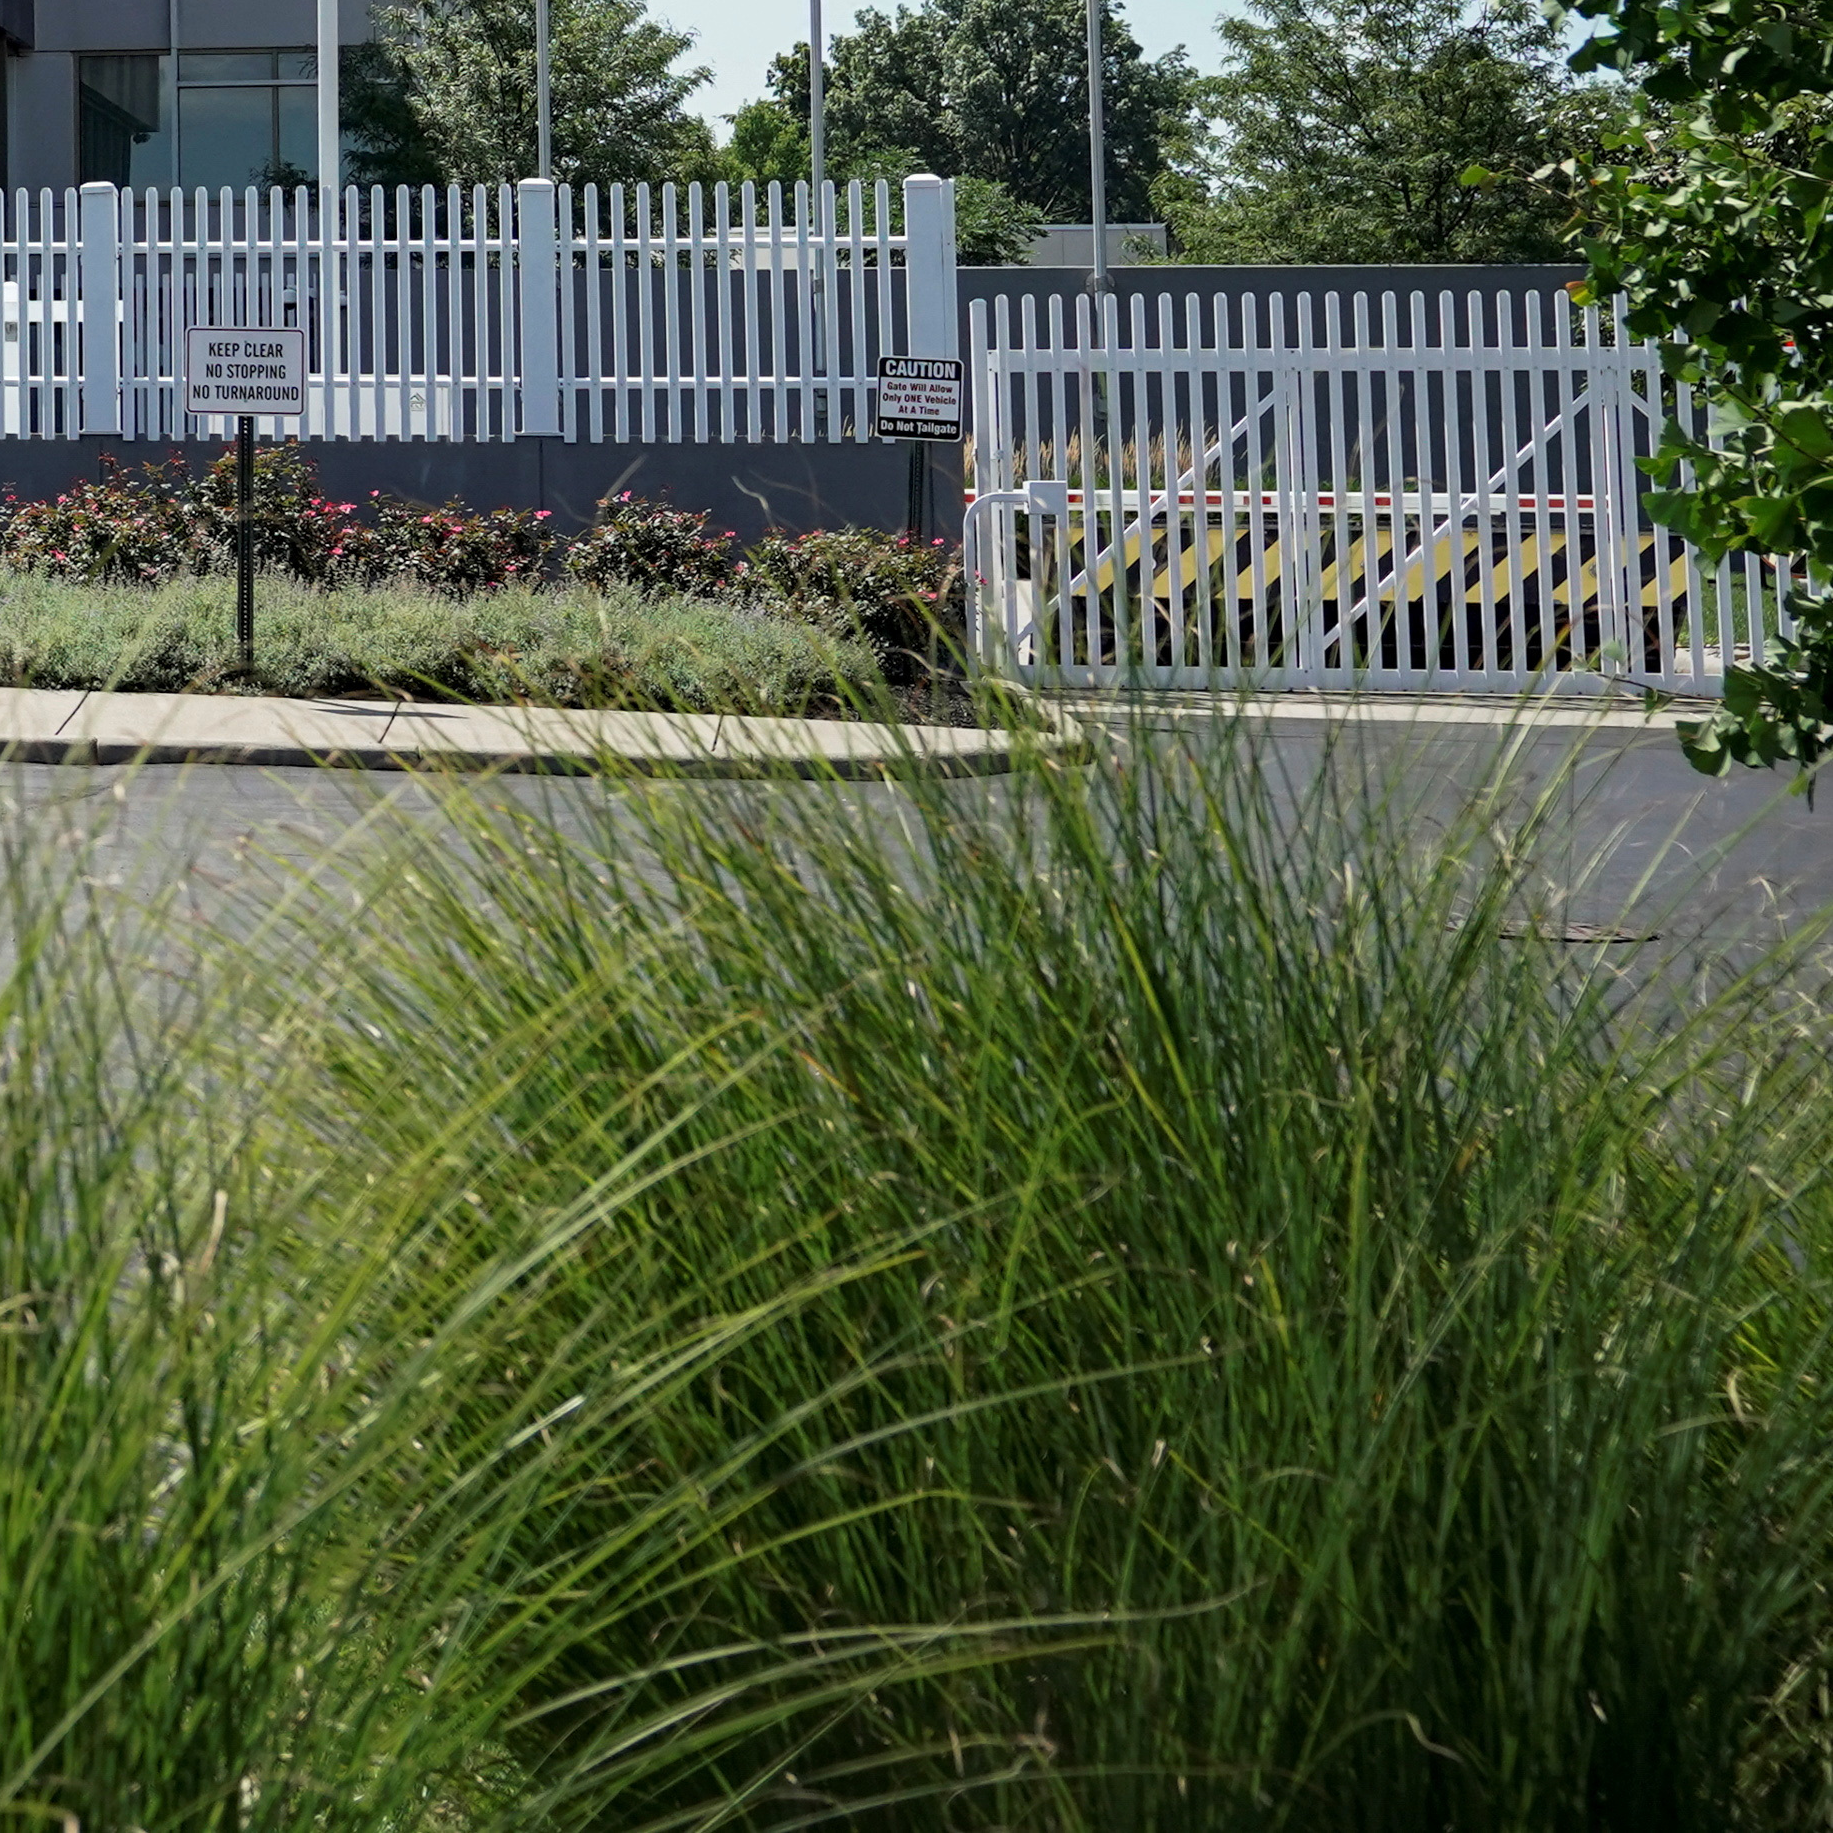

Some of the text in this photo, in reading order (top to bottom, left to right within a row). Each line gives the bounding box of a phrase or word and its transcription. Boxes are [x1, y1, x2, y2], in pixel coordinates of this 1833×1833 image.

[209, 342, 283, 358] KEEP CLEAR
[206, 364, 286, 379] NO STOPPING
[885, 359, 956, 379] CAUTION
[193, 385, 299, 401] NO TURNAROUND
[887, 381, 953, 393] Gate Will Allow
[882, 393, 957, 405] Only ONE Vehicle
[898, 405, 940, 415] At A Time
[880, 420, 957, 436] Do Not Tailgate
